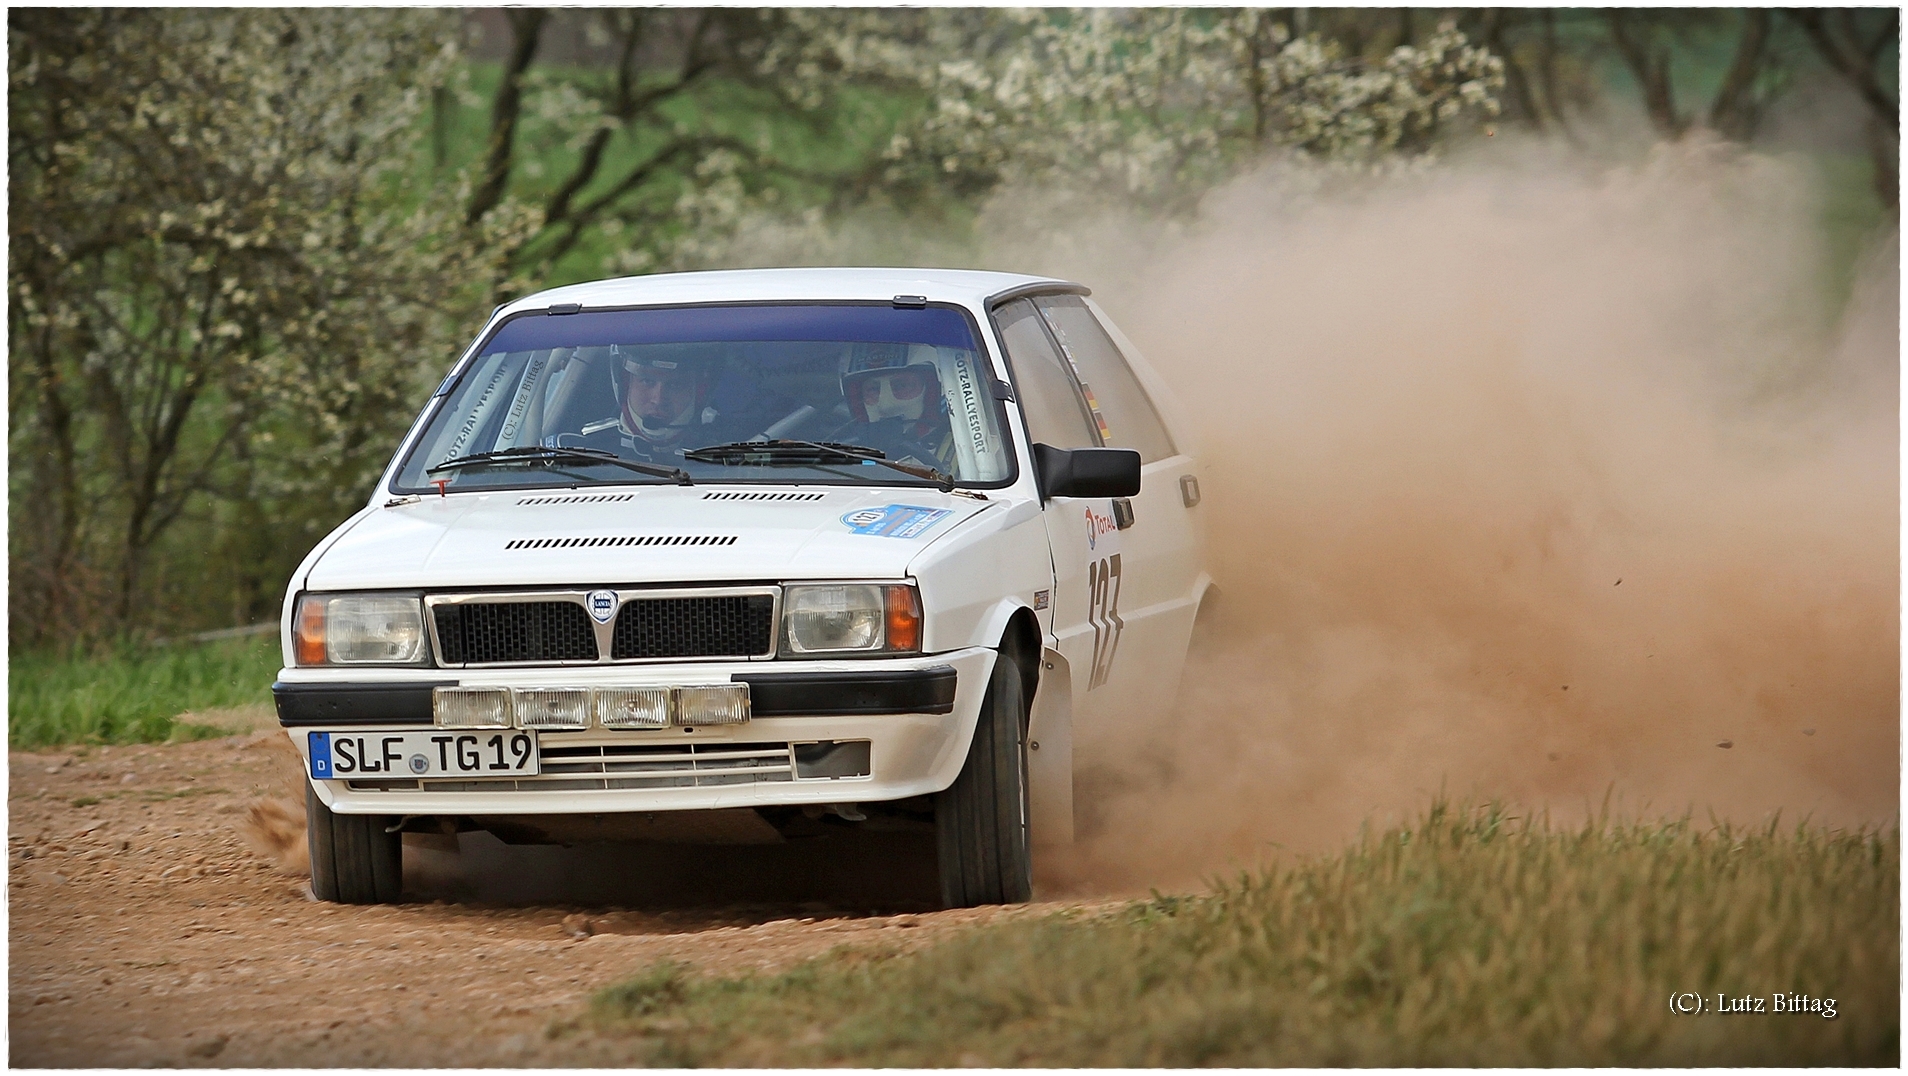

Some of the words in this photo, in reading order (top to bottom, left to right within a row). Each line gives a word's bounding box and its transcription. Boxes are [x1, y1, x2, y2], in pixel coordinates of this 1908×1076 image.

[852, 511, 881, 522] 127
[1086, 553, 1124, 692] 127
[317, 759, 326, 770] D
[333, 736, 404, 773] SLF
